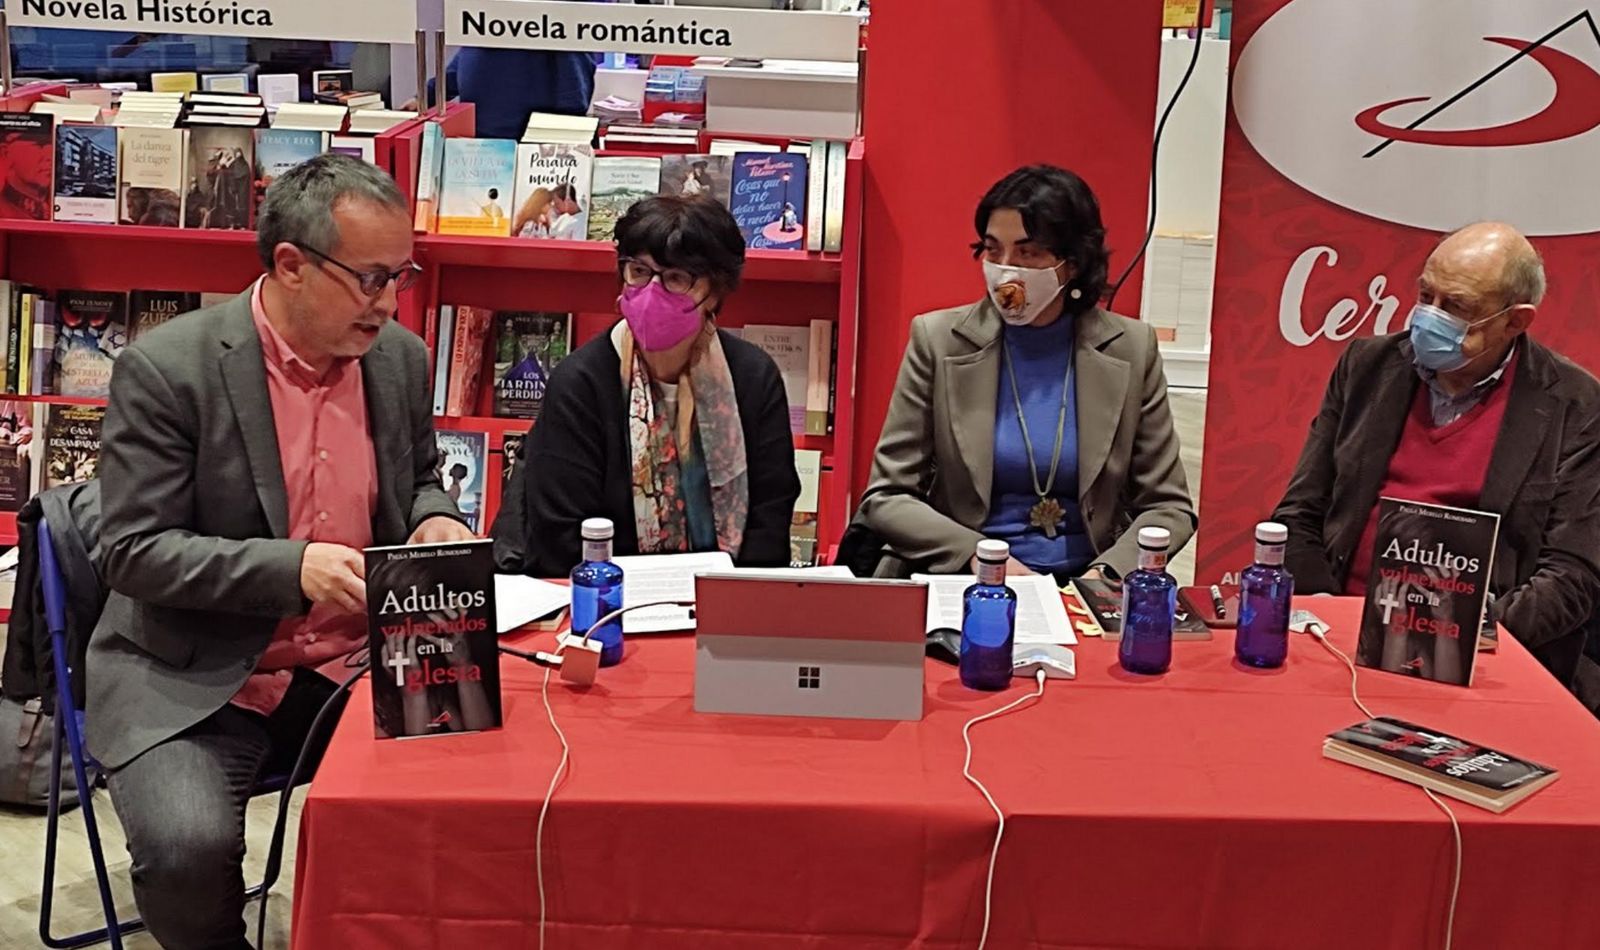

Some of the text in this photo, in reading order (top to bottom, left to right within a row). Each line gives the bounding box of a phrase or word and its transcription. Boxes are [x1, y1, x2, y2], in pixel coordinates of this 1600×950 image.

[21, 0, 273, 26] Novela Histórica
[462, 10, 732, 46] Novela romántica
[293, 137, 314, 146] REES
[528, 167, 578, 186] mundo
[734, 179, 762, 195] Cosas
[749, 191, 770, 204] no
[1279, 246, 1411, 347] Cer
[150, 299, 178, 312] LUIS
[524, 371, 540, 380] LOS
[501, 379, 546, 390] JARDIN
[502, 389, 545, 400] PERDID
[70, 426, 93, 435] CASA
[50, 438, 103, 450] DESAMPARAD
[1381, 537, 1480, 573] Adultos
[1380, 565, 1476, 594] vulnerados
[379, 583, 486, 615] Adultos
[1407, 591, 1441, 607] en la
[382, 608, 487, 637] vulnerados
[417, 638, 454, 655] en la
